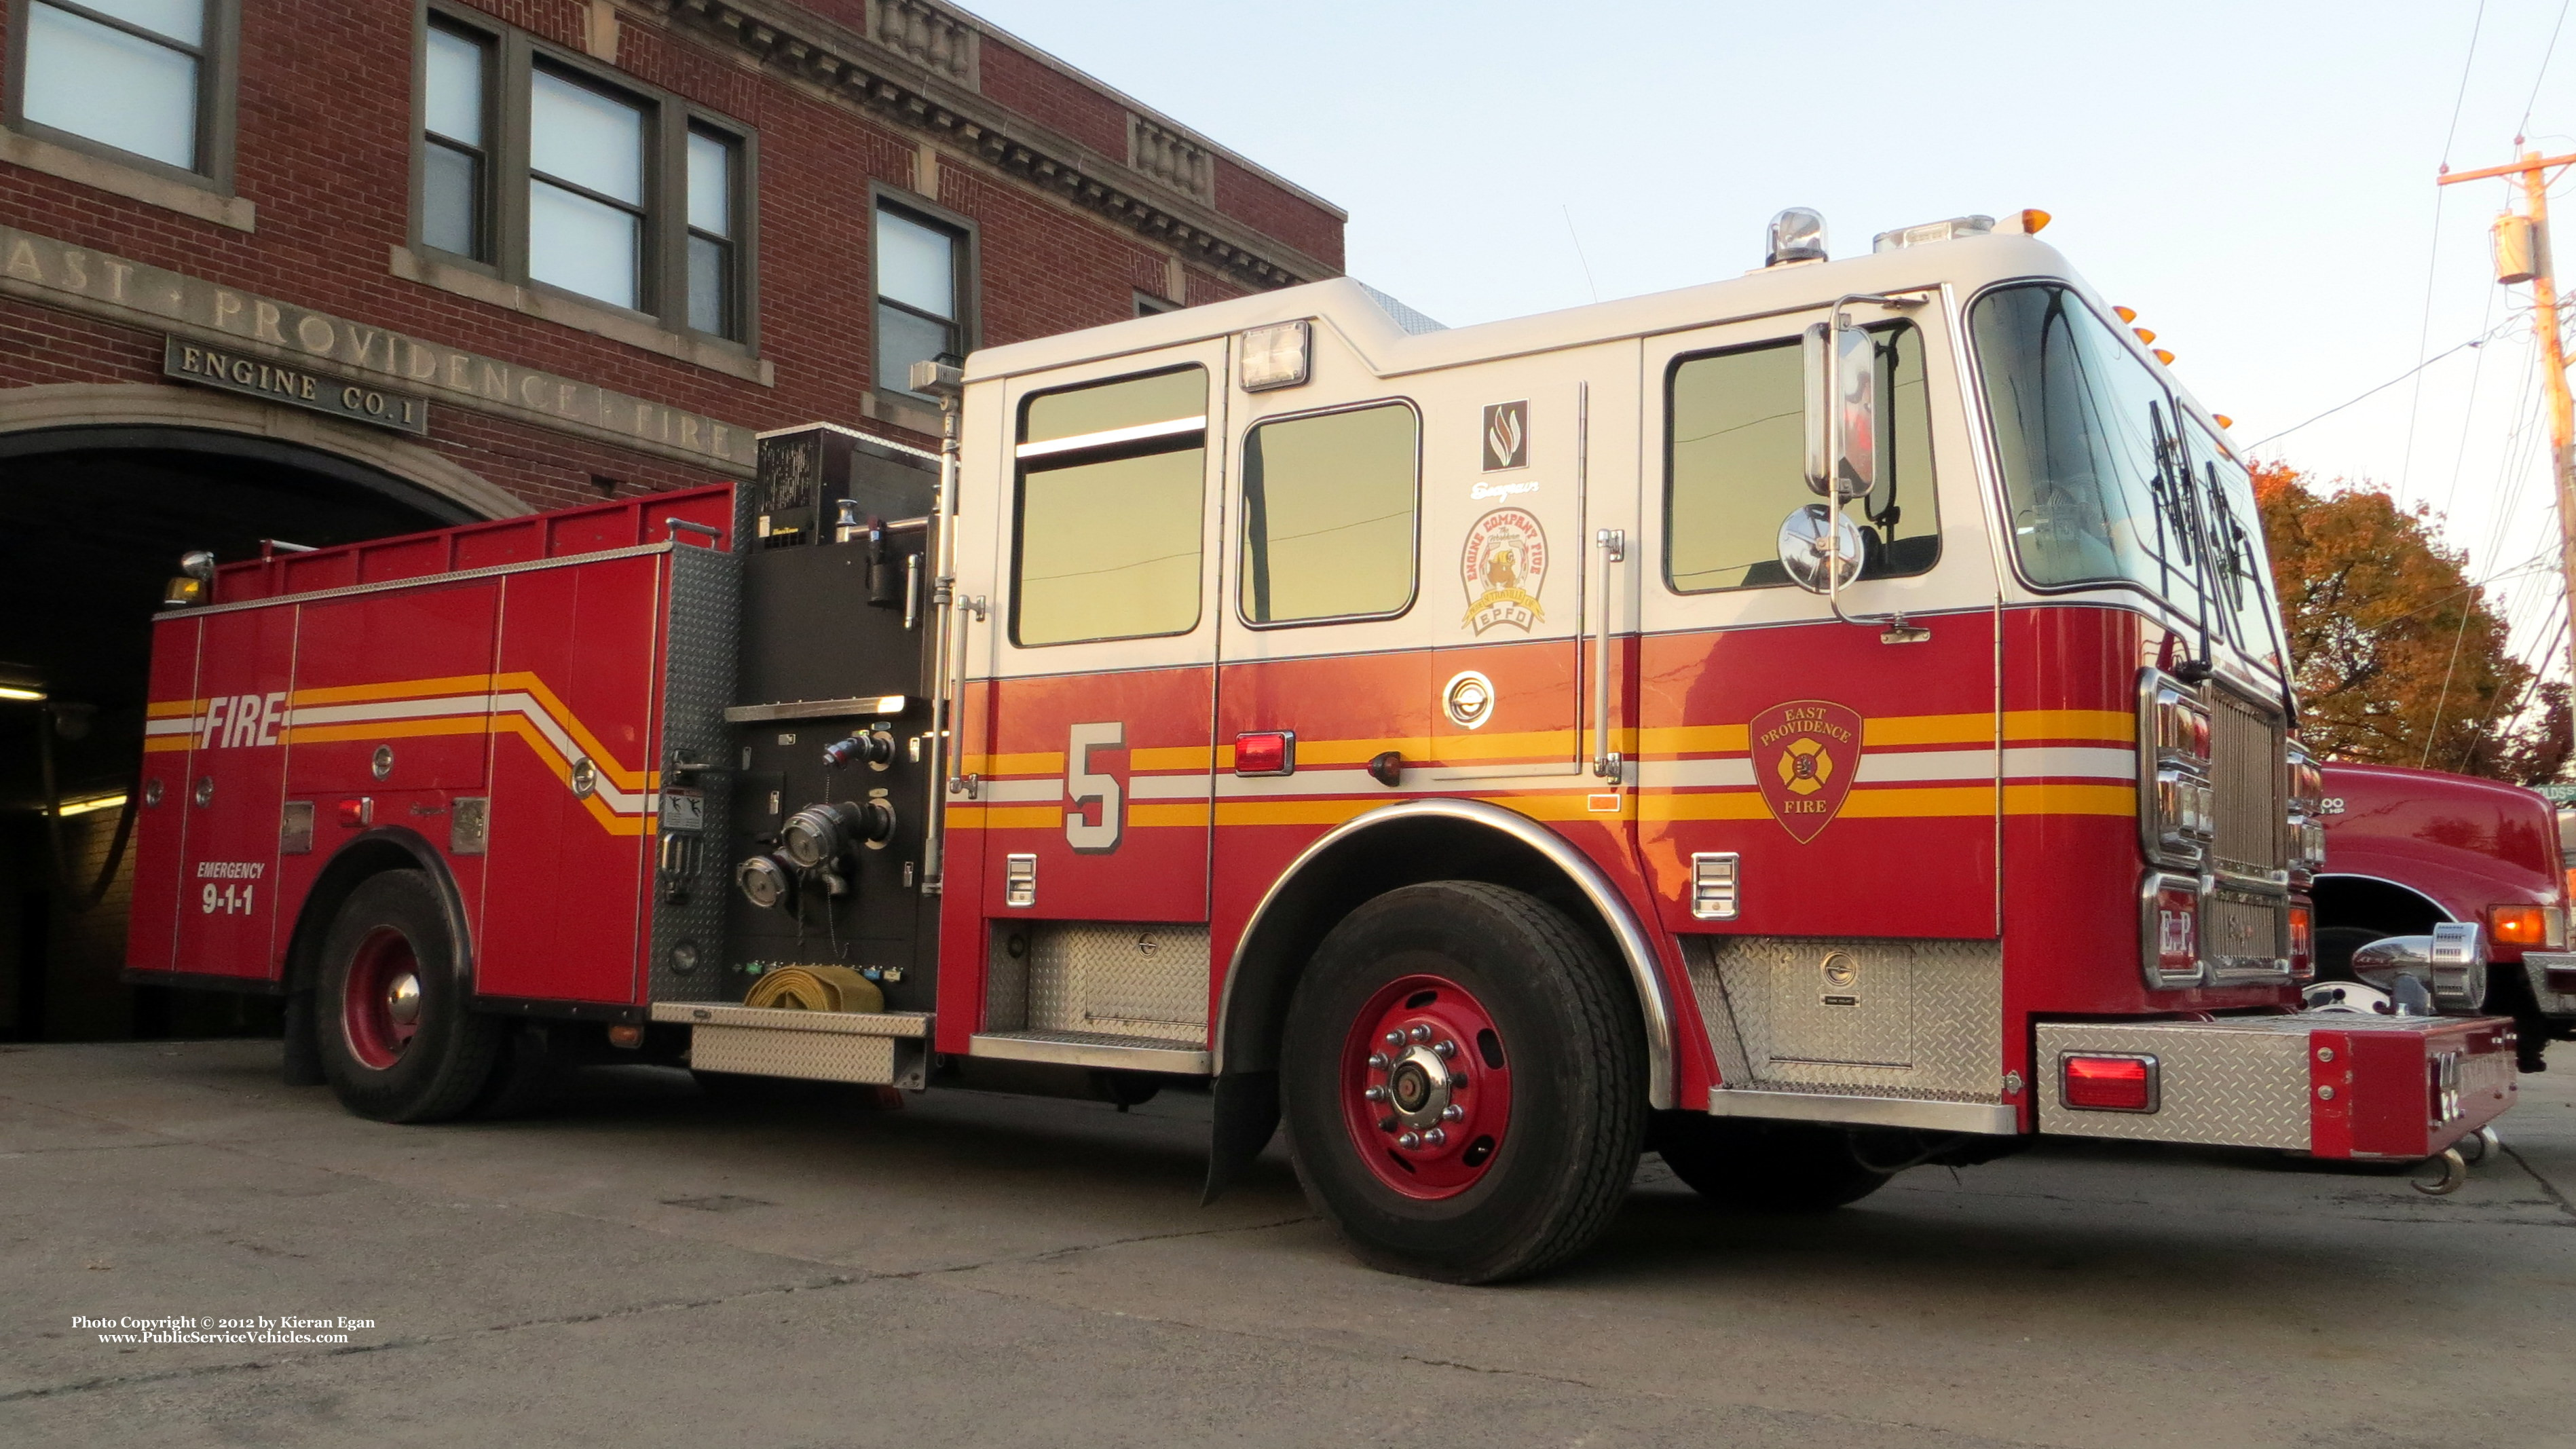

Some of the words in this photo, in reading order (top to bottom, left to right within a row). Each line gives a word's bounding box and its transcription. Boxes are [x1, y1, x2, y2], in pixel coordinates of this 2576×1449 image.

[181, 346, 317, 400] ENGINE
[214, 288, 581, 417] PROVIDENCE
[635, 404, 731, 459] FIRE
[1466, 533, 1484, 582] ENGINE
[1483, 514, 1537, 539] COMPANY
[1480, 608, 1526, 625] EPFD
[201, 692, 286, 749] FIRE
[1785, 707, 1826, 721] EAST
[1760, 721, 1851, 747] PROVIDENCE
[1066, 721, 1126, 855] 5
[1784, 799, 1827, 814] FIRE
[197, 861, 265, 879] EMERGENCY
[202, 883, 253, 915] 9-1-1
